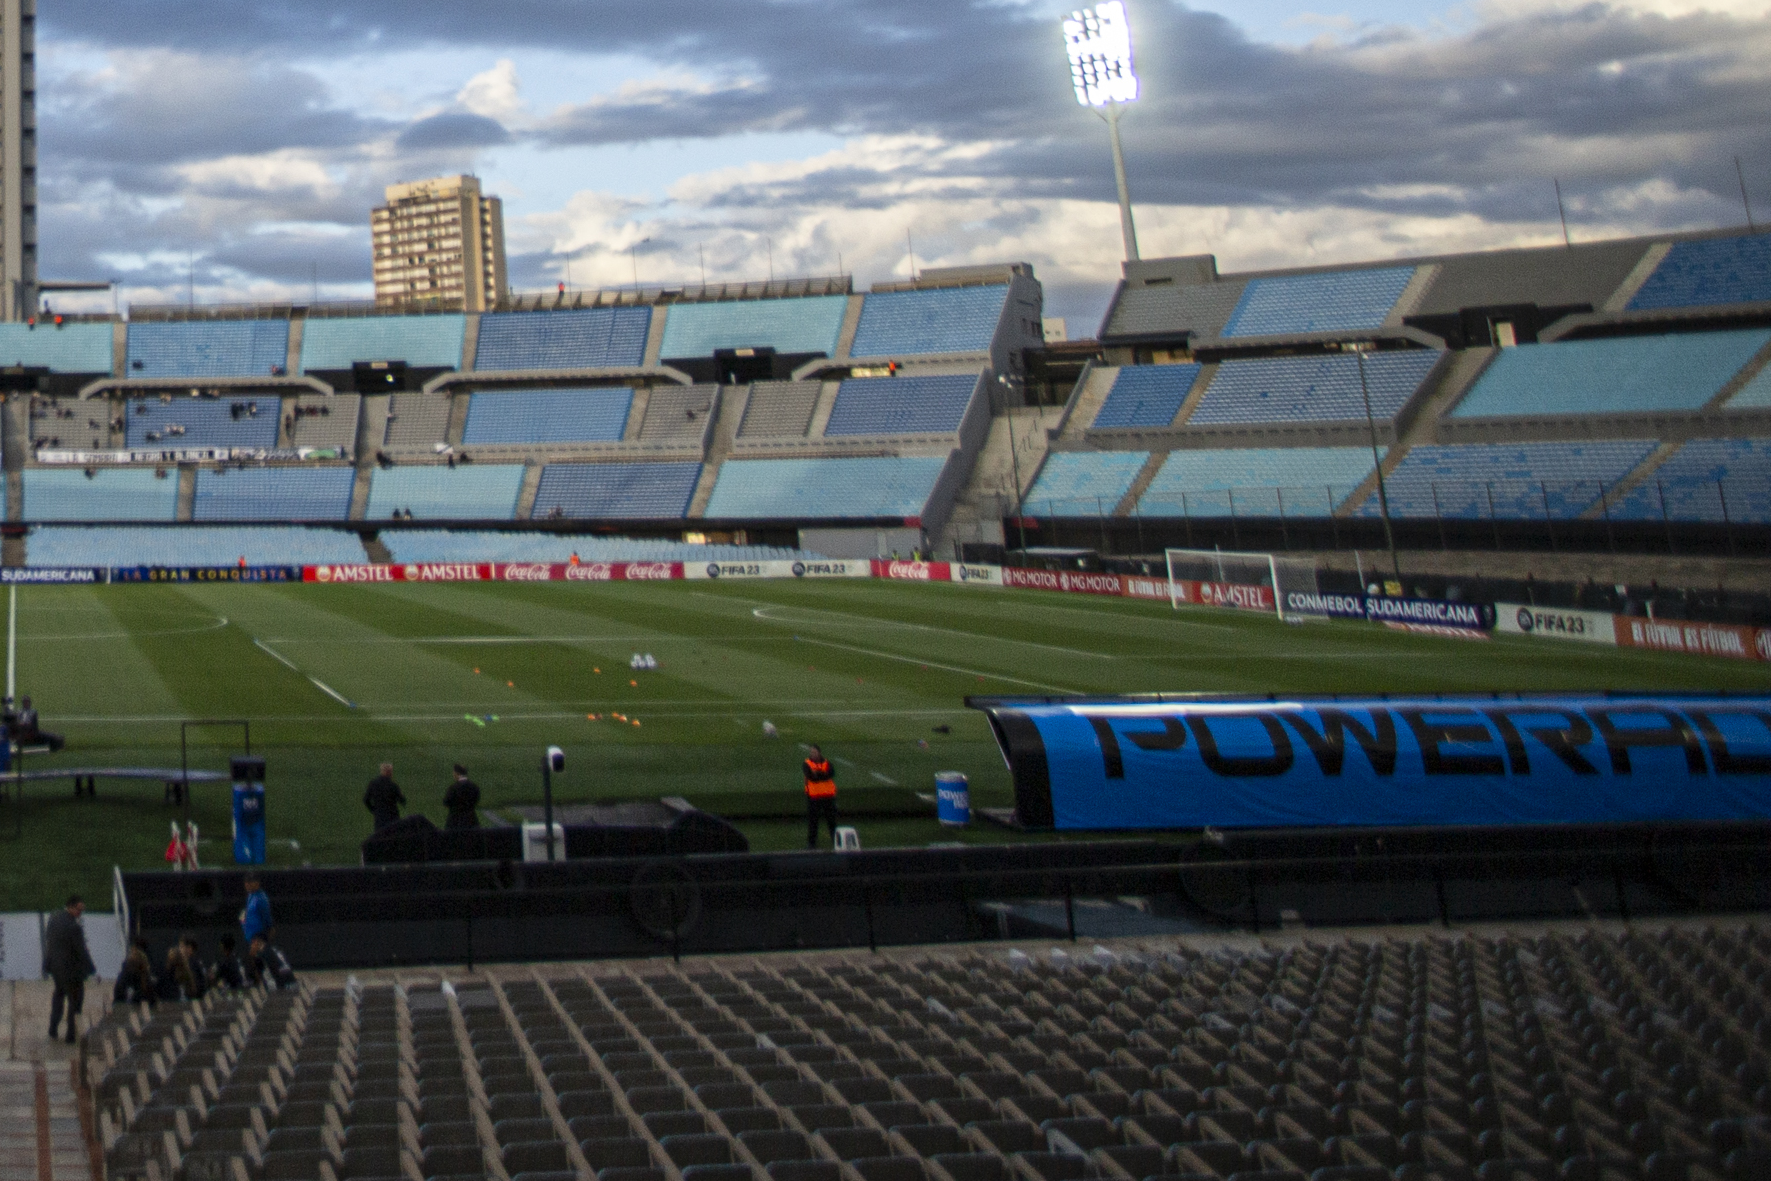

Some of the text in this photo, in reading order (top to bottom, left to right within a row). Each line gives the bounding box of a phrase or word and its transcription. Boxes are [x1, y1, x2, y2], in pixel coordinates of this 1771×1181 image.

[1, 570, 95, 582] SUDAMERICANA
[149, 570, 190, 582] GRAN
[196, 570, 288, 582] CONQUISTA
[333, 566, 394, 581] AMSTEL
[421, 564, 481, 580] AMSTEL
[1027, 571, 1058, 588] MOTOR
[1086, 575, 1120, 593] MOTOR
[1287, 592, 1480, 624] CONMEBOL SUDAMERICANA
